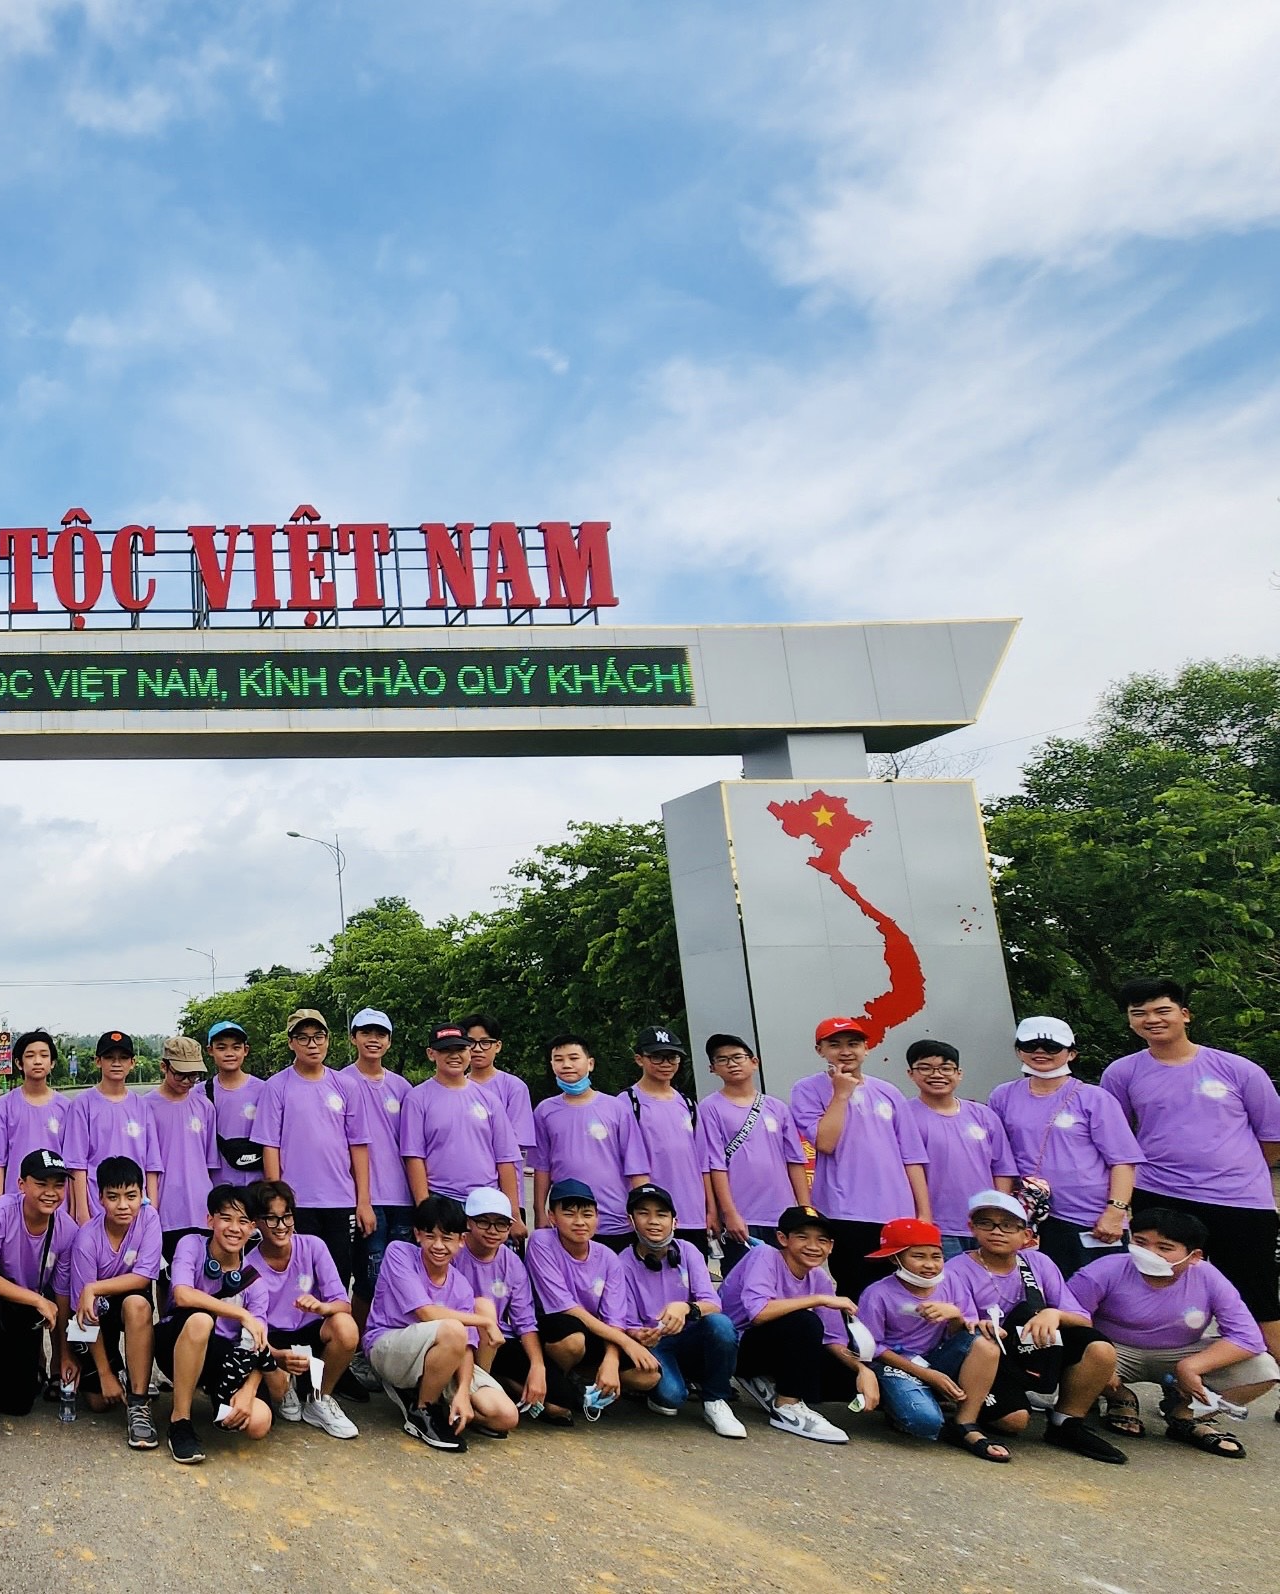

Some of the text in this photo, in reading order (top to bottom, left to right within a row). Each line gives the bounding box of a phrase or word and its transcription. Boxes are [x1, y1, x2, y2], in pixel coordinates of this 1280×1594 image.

[188, 504, 391, 627] VIỆT
[421, 521, 619, 609] NAM
[44, 666, 128, 703] VIỆT
[137, 668, 228, 702] NAM,
[239, 660, 328, 698] KÍNH
[337, 659, 448, 697] CHÀO
[456, 657, 538, 695] QUÝ
